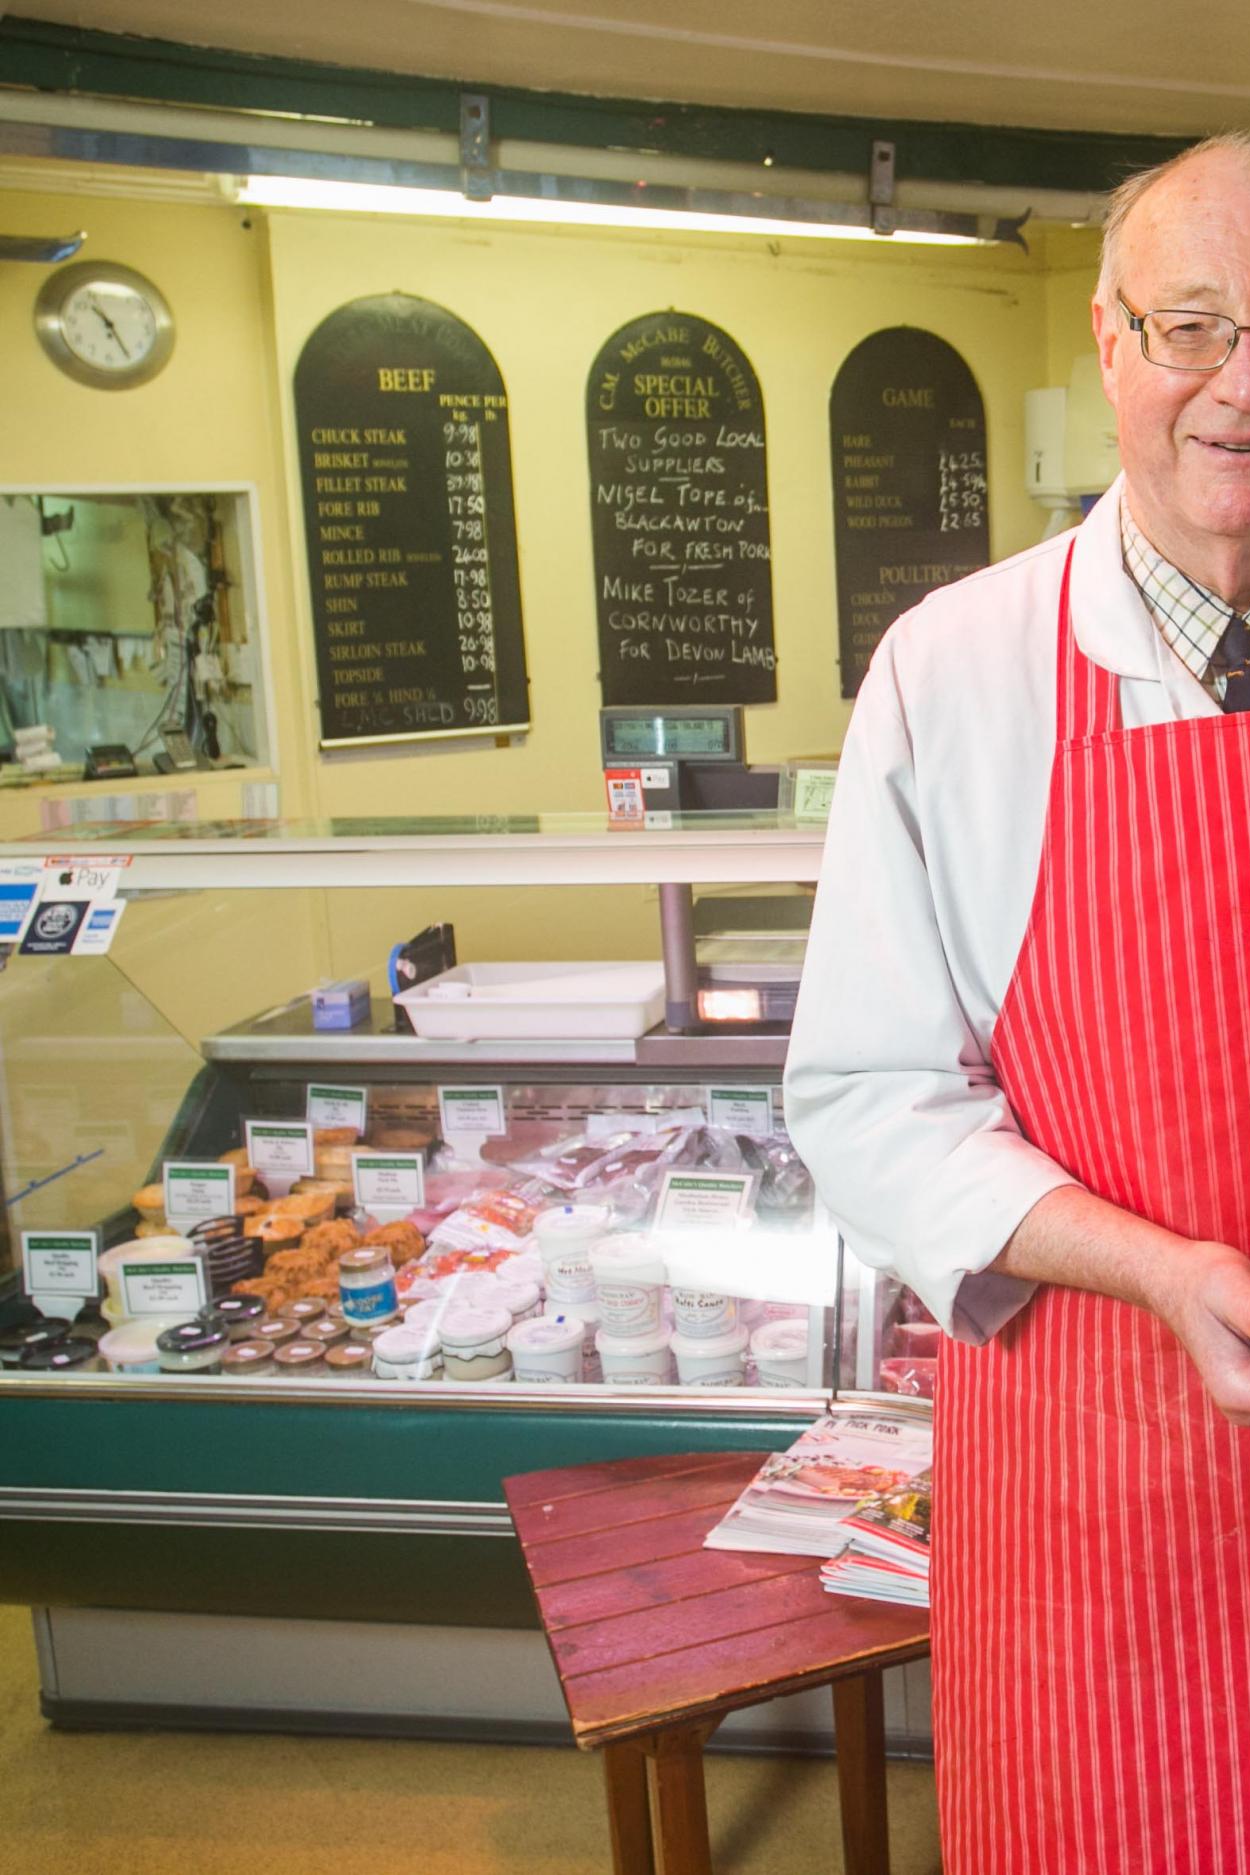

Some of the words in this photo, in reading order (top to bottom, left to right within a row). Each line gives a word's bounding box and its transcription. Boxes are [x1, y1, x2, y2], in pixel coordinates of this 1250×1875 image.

[377, 367, 436, 393] BEEF
[633, 373, 720, 398] SPECIAL
[439, 394, 480, 409] PENCE
[484, 395, 507, 409] PER
[645, 396, 711, 419] OFFER
[882, 386, 936, 409] GAME
[311, 428, 360, 446] CHUCK
[364, 428, 408, 445] STEAK
[314, 452, 369, 470] BRISKET
[624, 454, 726, 474] SUPPLIERS
[316, 477, 361, 494] FILLET
[364, 477, 408, 493] STEAK
[317, 502, 353, 518] FORE
[356, 501, 382, 518] RIB
[597, 483, 665, 514] NIGEL
[319, 524, 366, 542] MINCE
[615, 511, 744, 533] BLACKAWTON
[321, 549, 375, 566] ROLLED
[378, 548, 402, 563] RIB
[632, 539, 677, 562] FOR
[685, 540, 733, 562] FRESH
[323, 573, 363, 590] RUMP
[366, 570, 409, 588] STEAK
[879, 563, 952, 586] POULTRY
[603, 575, 655, 603] MIKE
[662, 575, 729, 608] TOZER
[324, 597, 358, 614] SHIN
[326, 620, 366, 638] SKIRT
[608, 611, 759, 640] CORNWORTHY
[329, 643, 381, 662] SIRLOIN
[383, 640, 428, 658] STEAK
[619, 638, 651, 662] FOR
[665, 637, 726, 663] DEVON
[731, 639, 777, 672] LAMB
[333, 667, 384, 686] TOPSIDE
[334, 690, 370, 708] FORE
[389, 686, 424, 704] HIND
[77, 867, 111, 890] Pay
